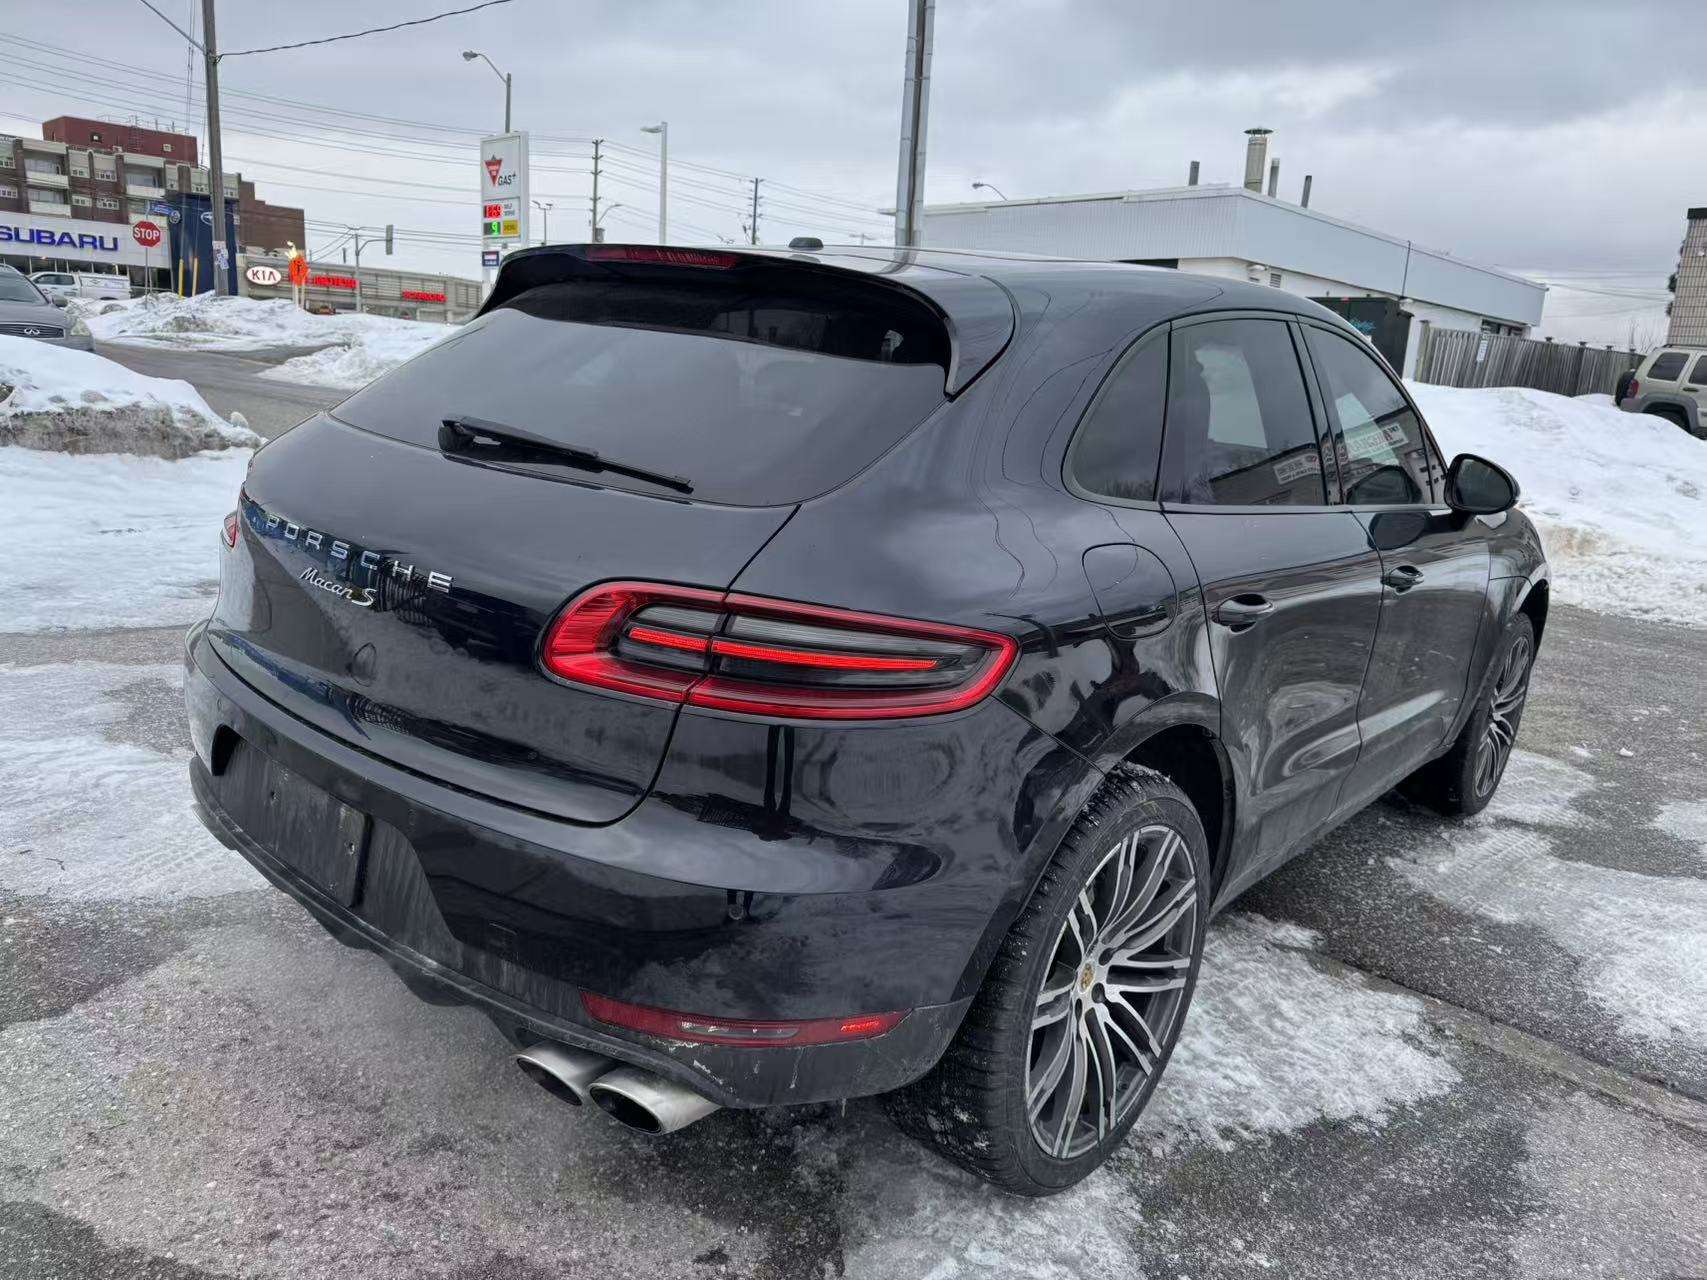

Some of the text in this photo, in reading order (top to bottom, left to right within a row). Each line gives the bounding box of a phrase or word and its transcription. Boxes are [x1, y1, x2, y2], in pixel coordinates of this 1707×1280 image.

[0, 225, 119, 251] SUBARU
[133, 227, 160, 241] STOP
[251, 270, 277, 282] KIA
[266, 514, 453, 593] PORSCHE
[300, 567, 377, 607] Macan S
